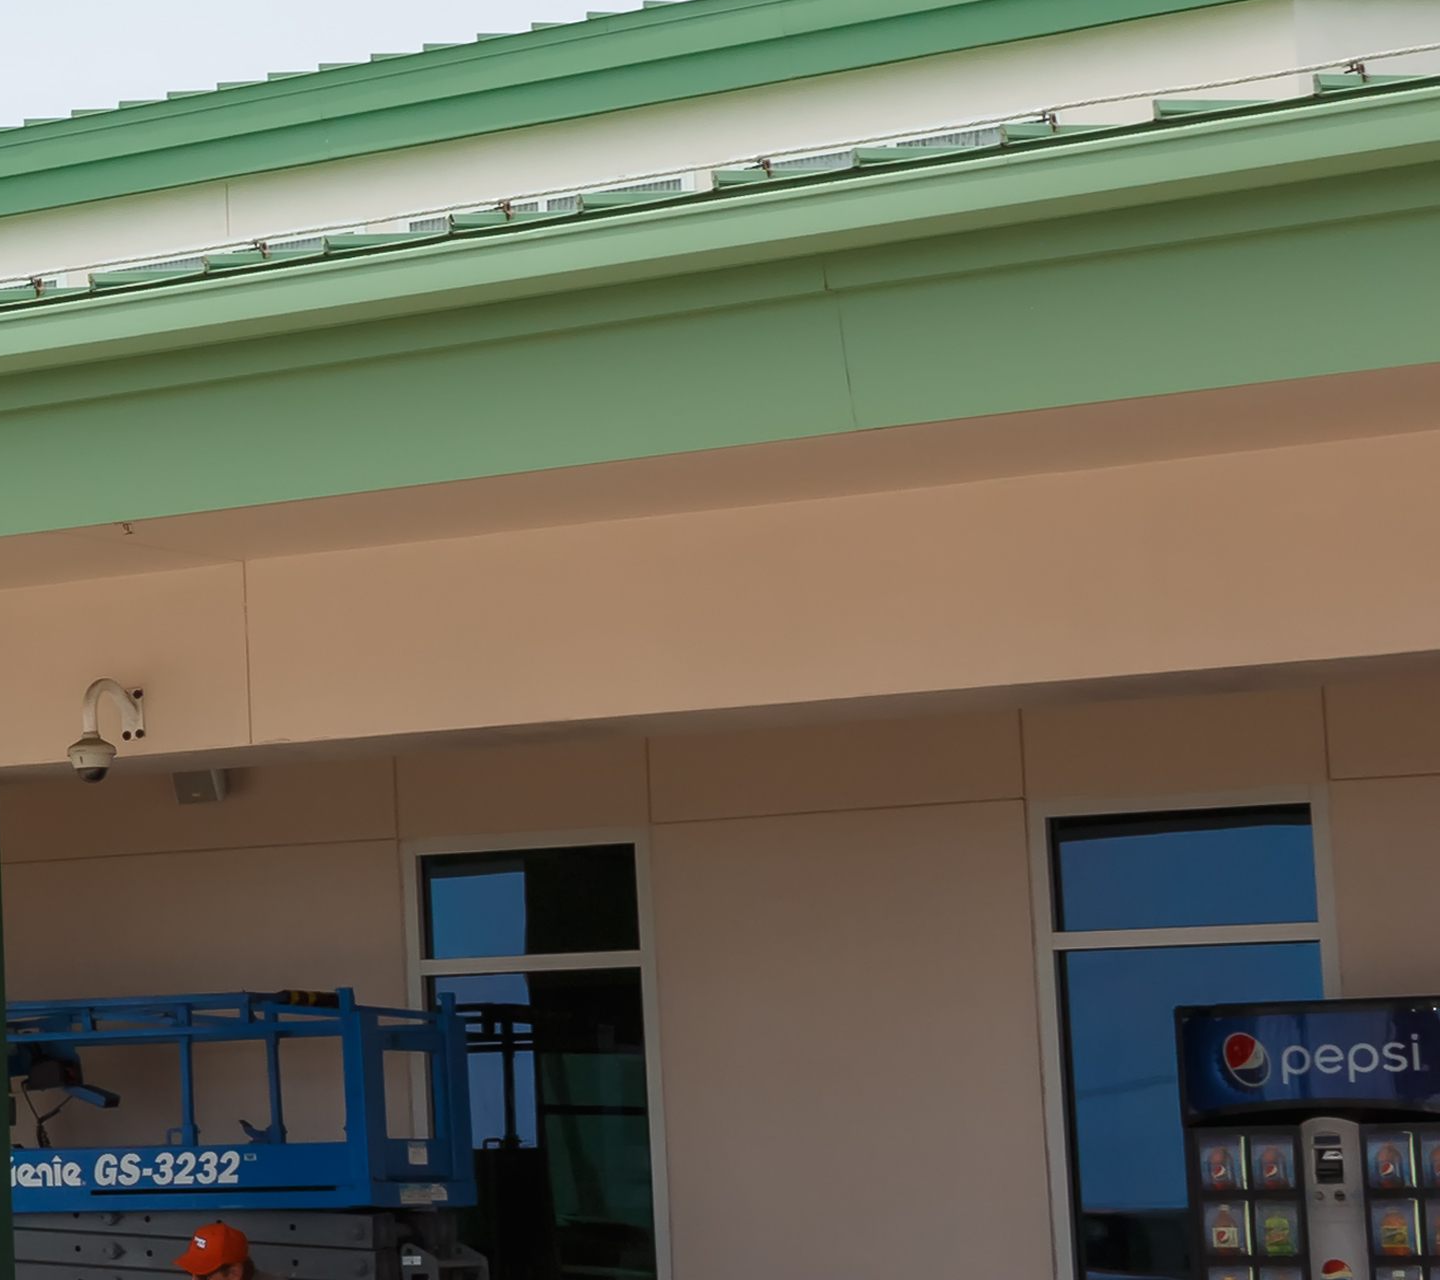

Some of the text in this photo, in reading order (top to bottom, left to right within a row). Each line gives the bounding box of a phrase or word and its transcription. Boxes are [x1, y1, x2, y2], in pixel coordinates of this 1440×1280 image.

[1281, 1032, 1422, 1085] pepsi
[10, 1150, 241, 1187] enie GS-3232
